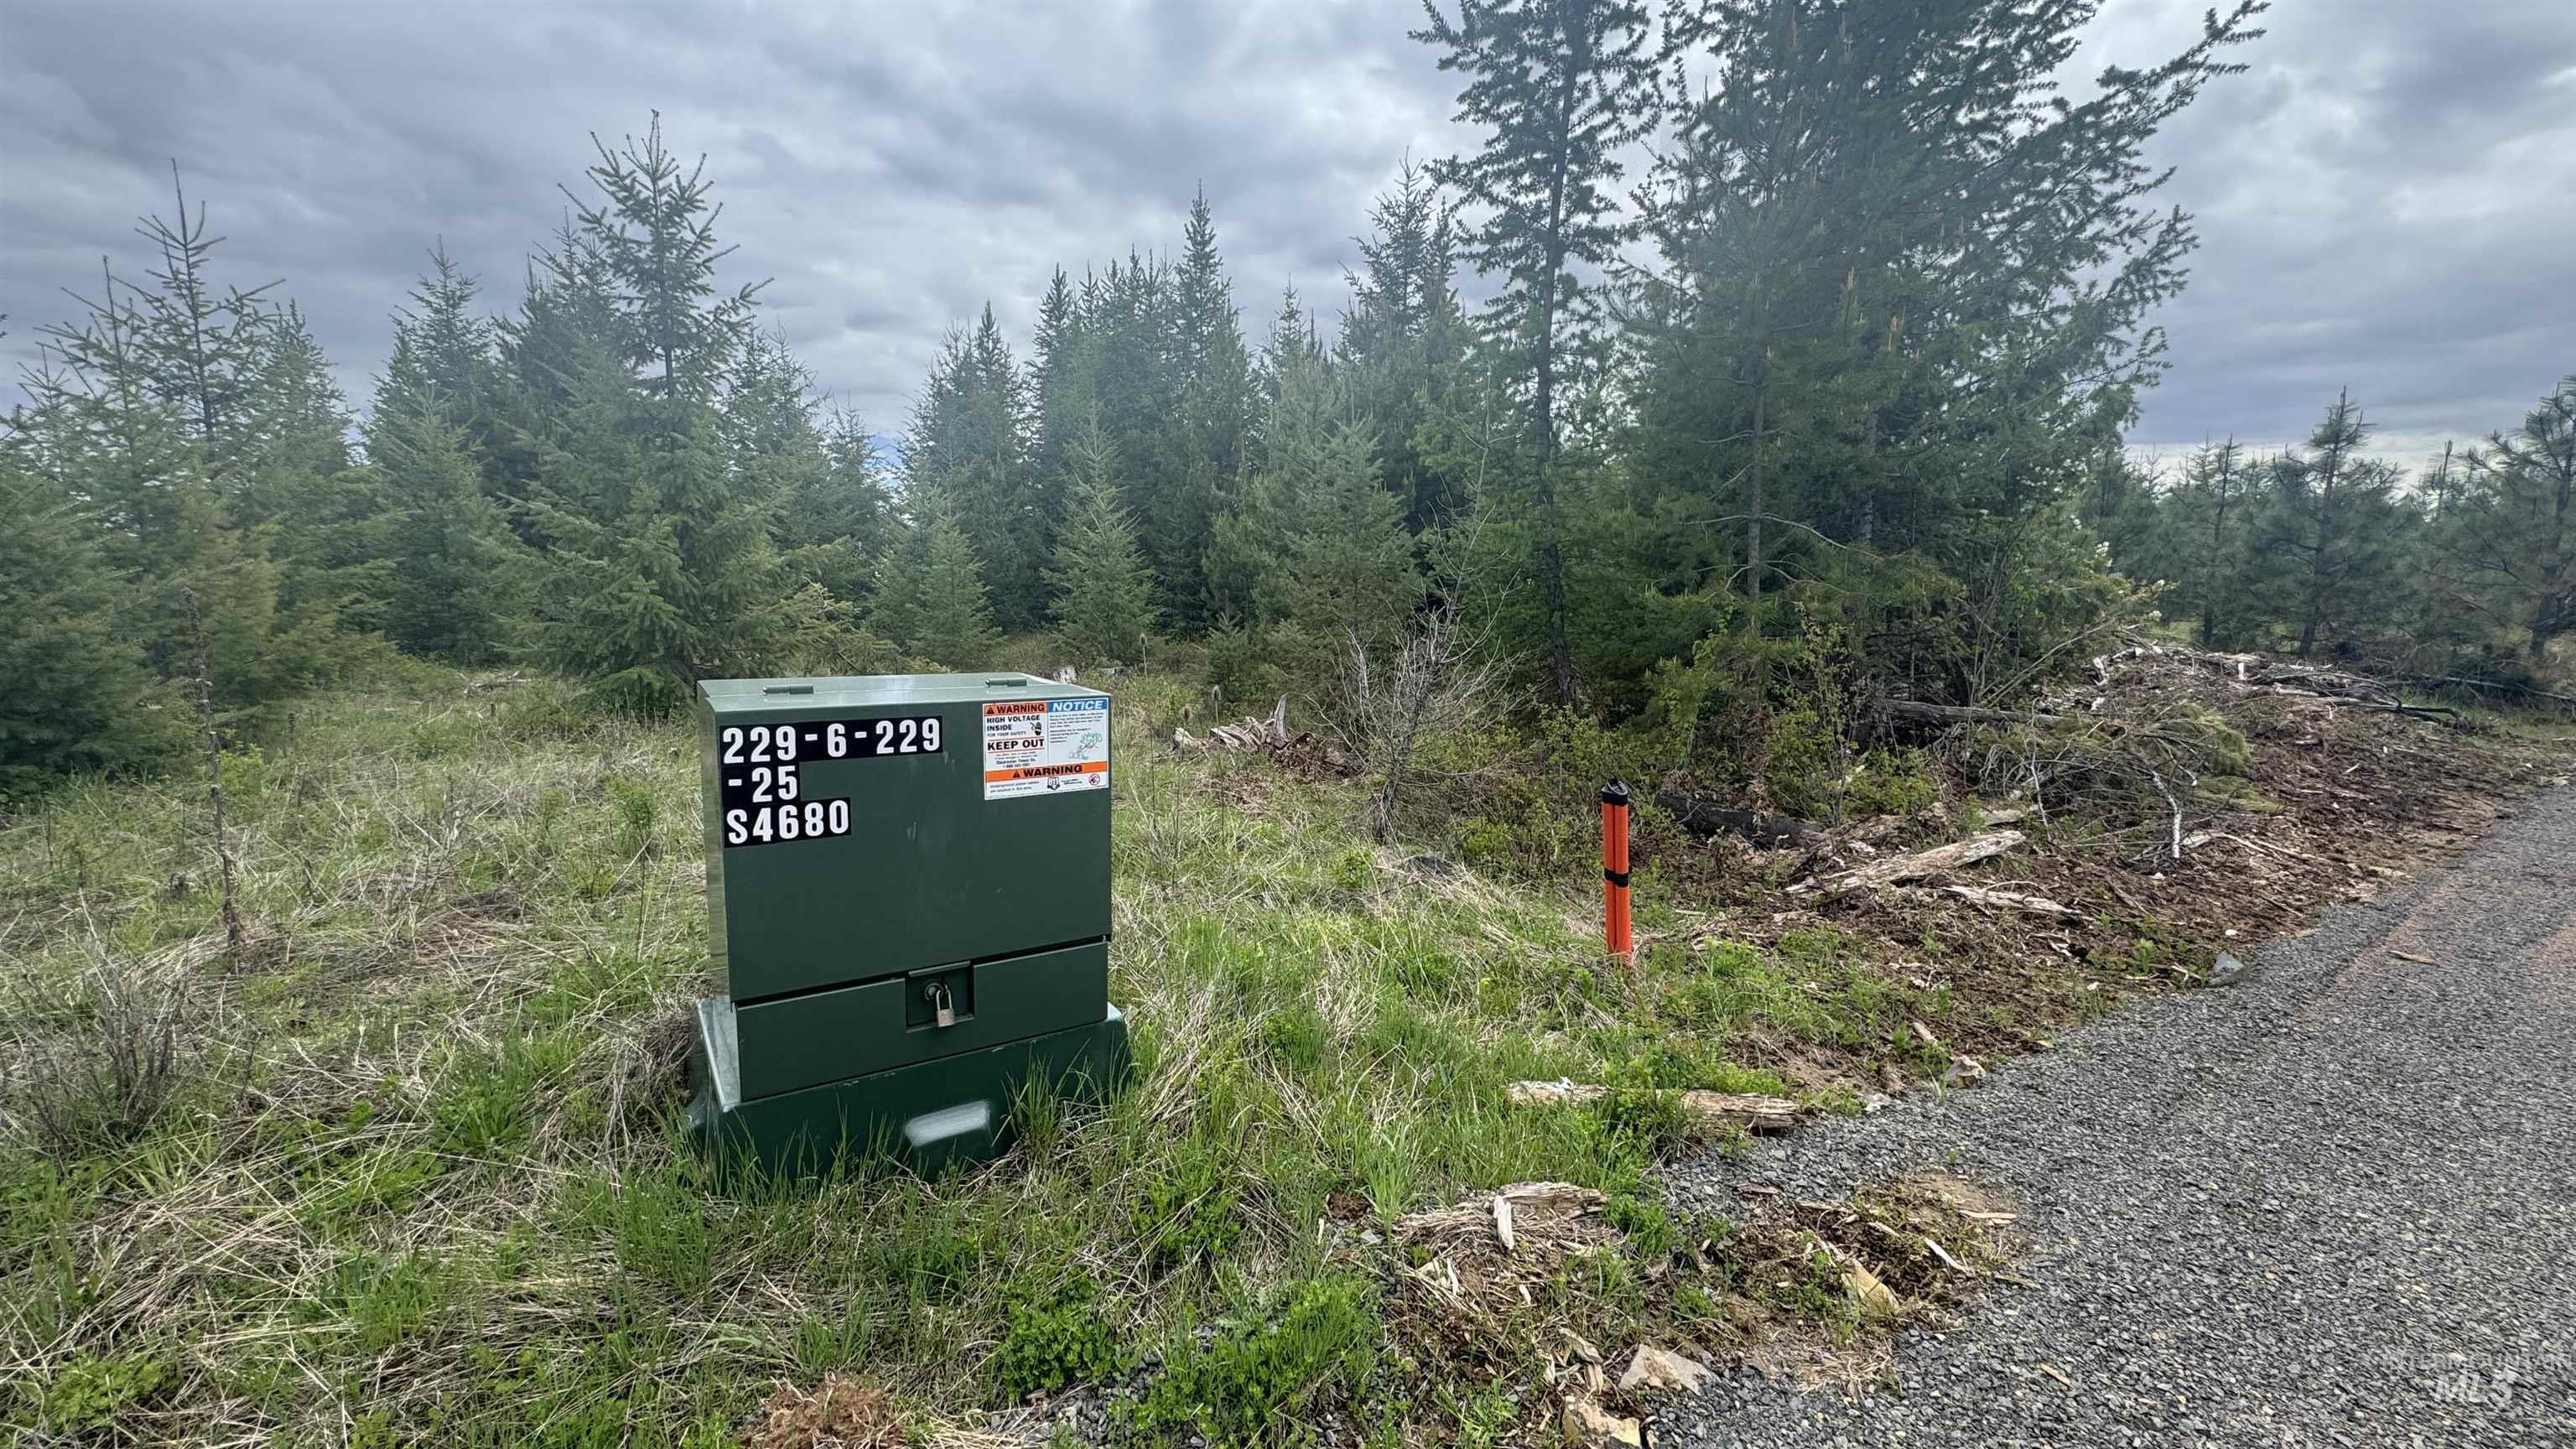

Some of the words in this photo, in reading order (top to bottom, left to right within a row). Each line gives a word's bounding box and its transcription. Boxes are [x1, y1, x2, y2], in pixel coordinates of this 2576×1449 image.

[996, 704, 1045, 714] WARNING
[1052, 700, 1104, 711] NOTICE
[723, 718, 940, 764] 229-6-229
[987, 740, 1019, 750] KEEP
[1022, 739, 1045, 748] OUT
[1023, 764, 1083, 777] WARNING
[1047, 776, 1060, 786] 811
[726, 800, 849, 844] S4680
